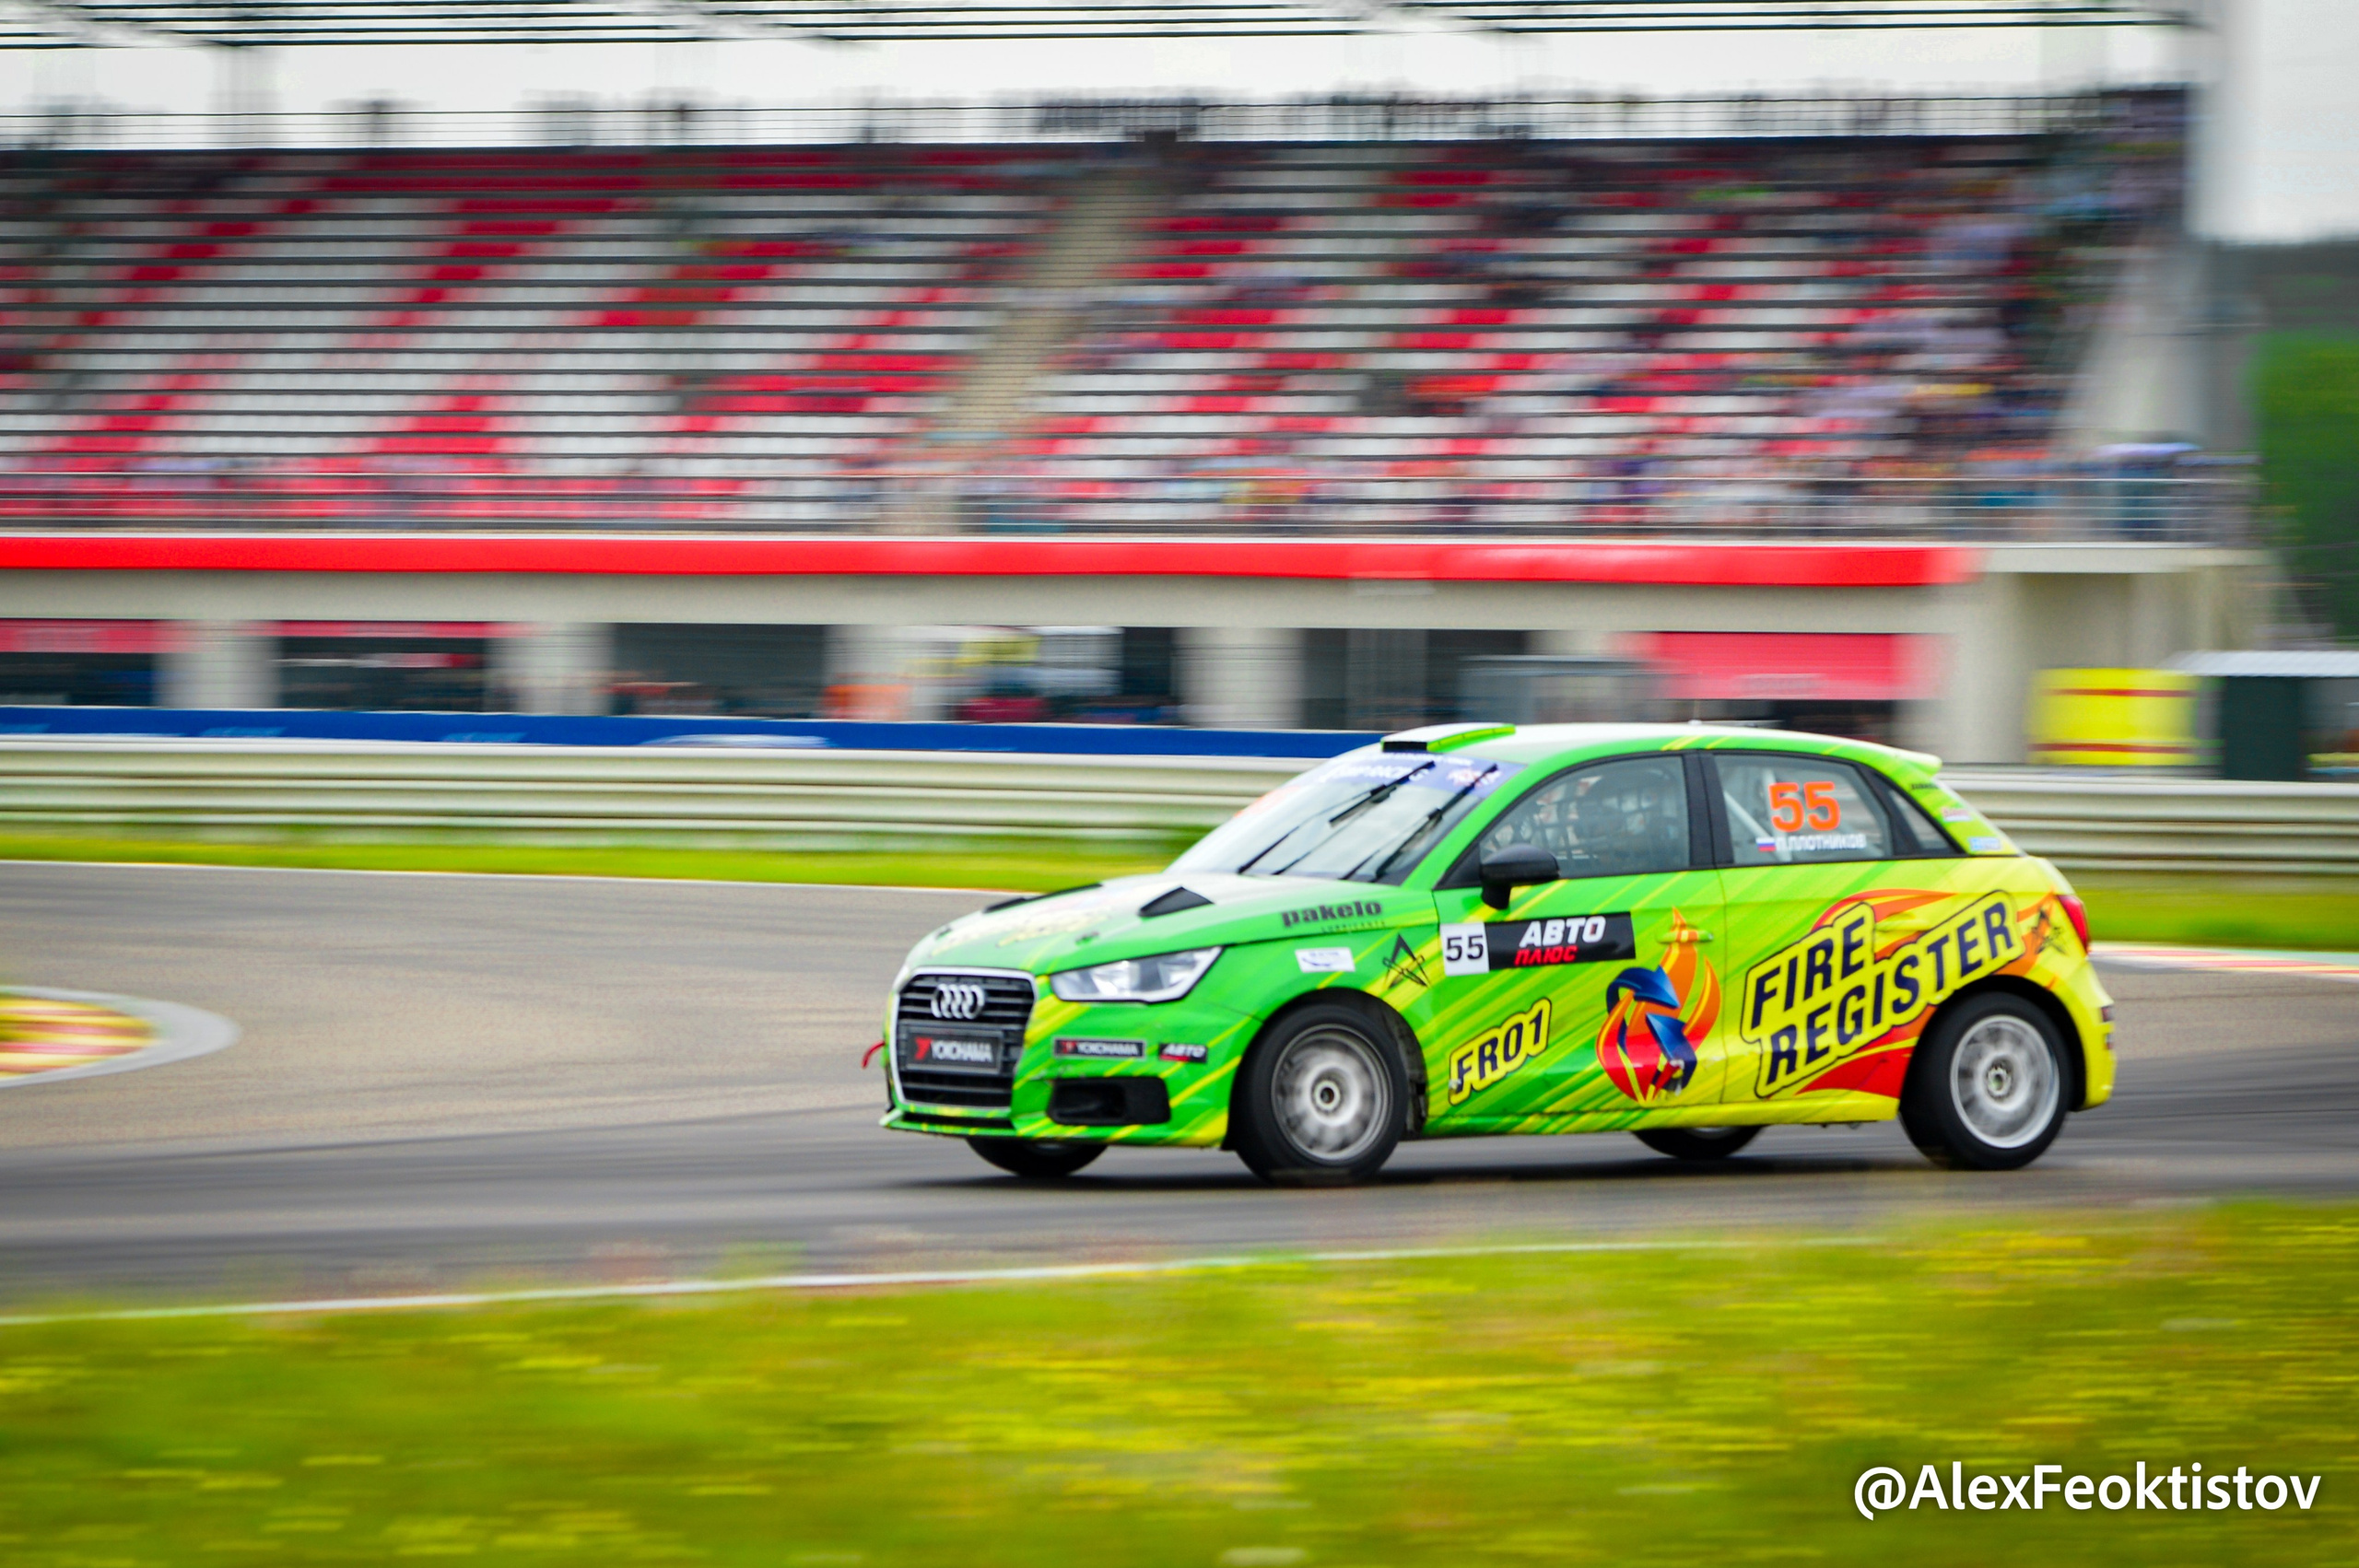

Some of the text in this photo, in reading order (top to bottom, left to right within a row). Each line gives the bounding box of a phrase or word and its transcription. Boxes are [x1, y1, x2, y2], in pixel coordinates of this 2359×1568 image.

[1768, 781, 1841, 832] 55
[1282, 900, 1382, 928] pakelo
[1519, 916, 1606, 948] АВТО
[1446, 934, 1485, 962] 55
[1514, 945, 1579, 966] ПЛЮС
[1751, 917, 1866, 1030] FIRE
[1766, 901, 2015, 1085] REGISTER
[931, 1040, 993, 1062] YOKOHAMA
[1077, 1042, 1140, 1057] YOKOHAMA
